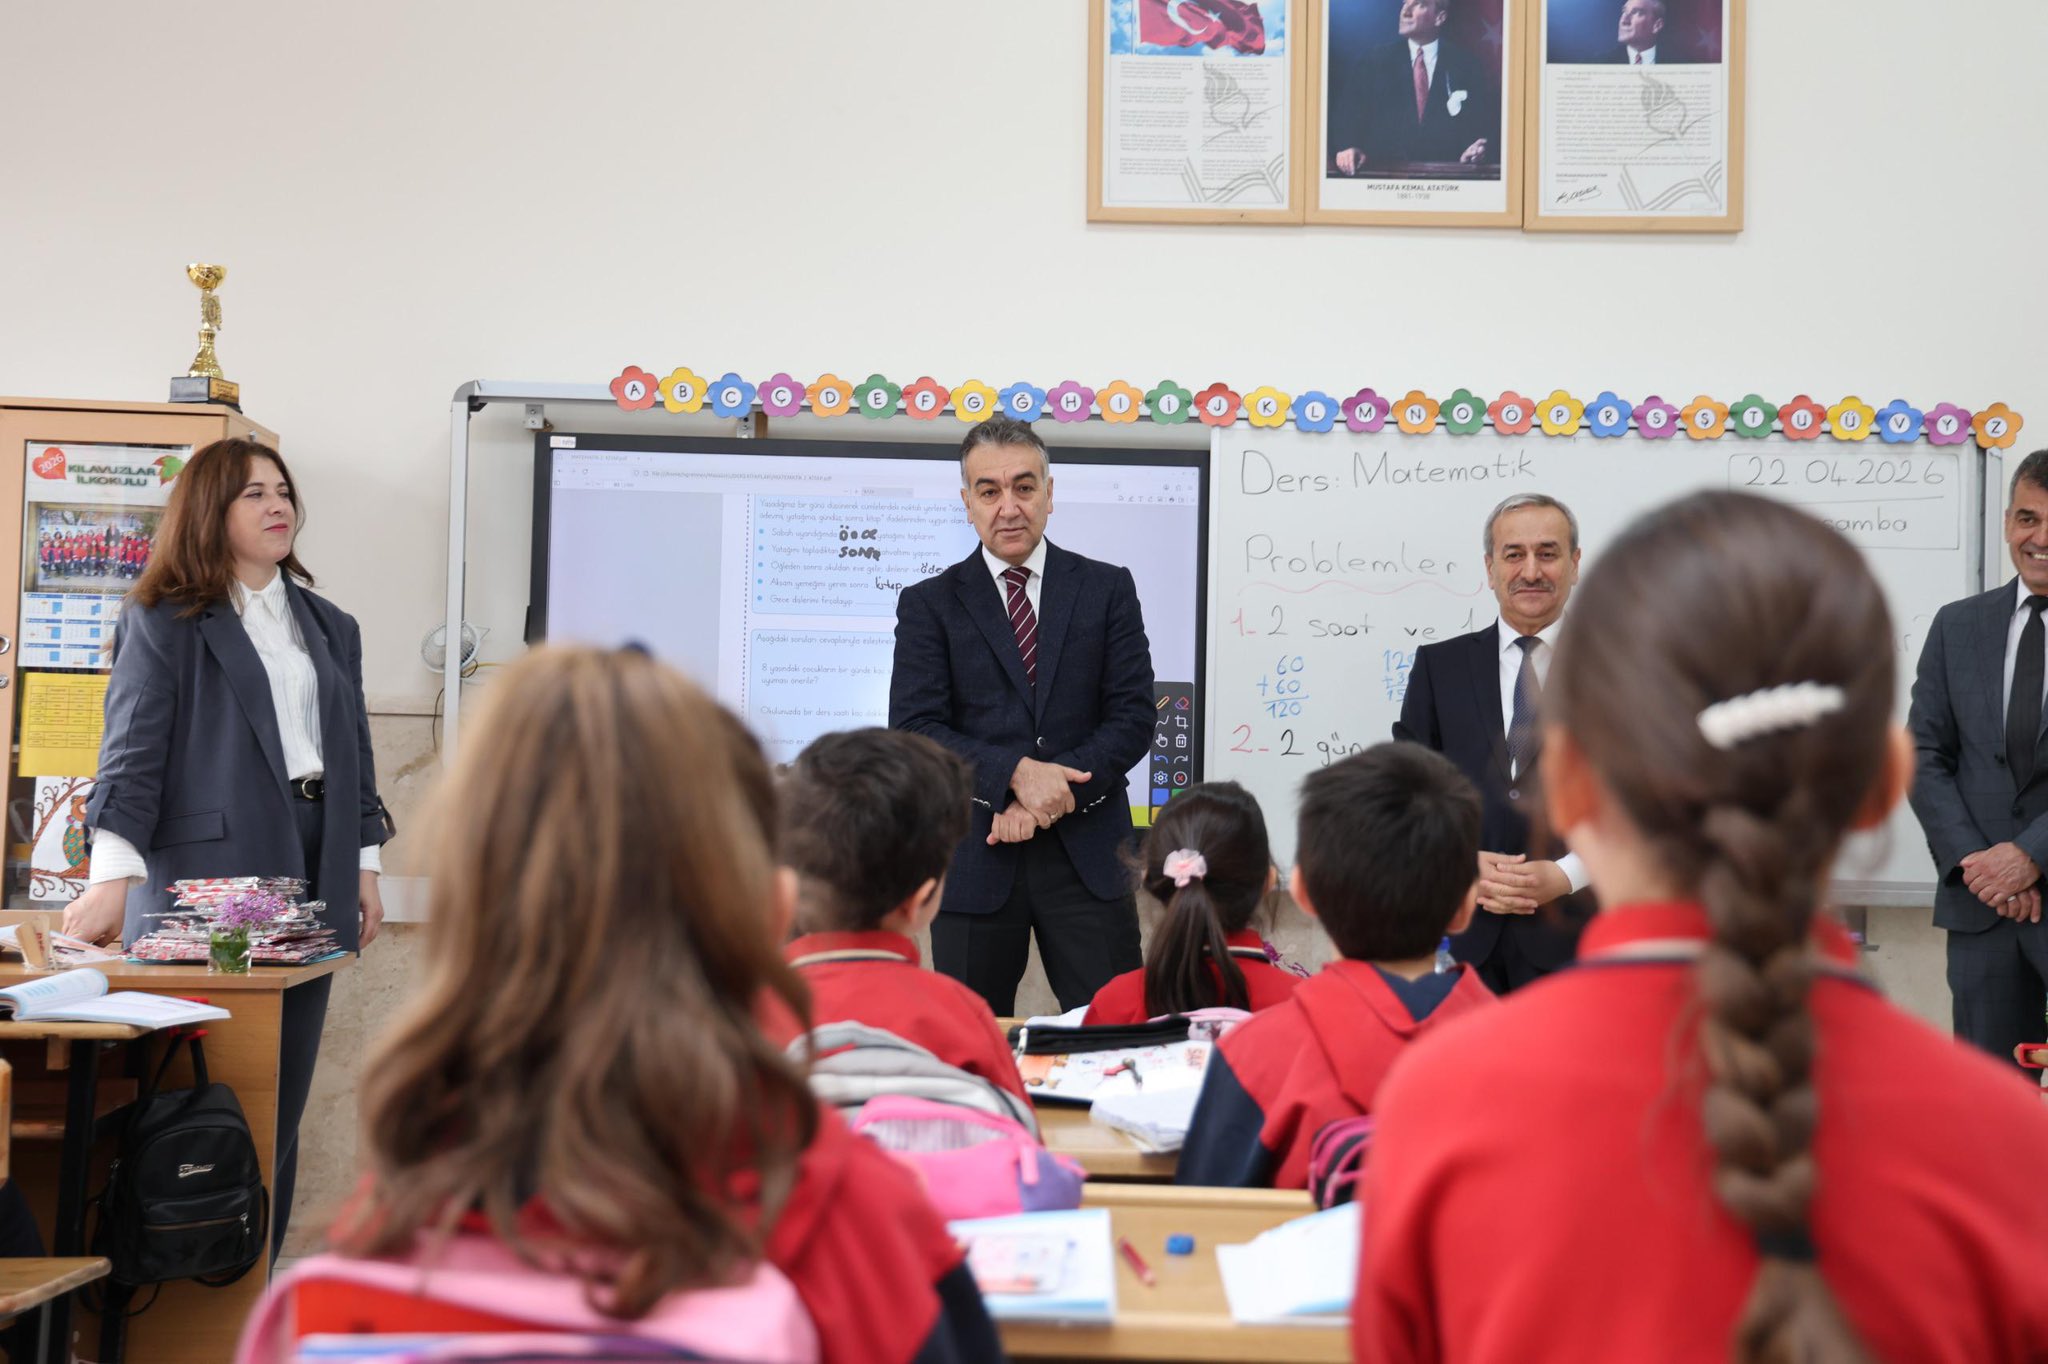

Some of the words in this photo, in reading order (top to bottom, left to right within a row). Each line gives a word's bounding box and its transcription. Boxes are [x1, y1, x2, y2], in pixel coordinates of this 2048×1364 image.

[1401, 184, 1425, 192] KEMAL
[1427, 184, 1460, 192] ATATÜRK
[631, 384, 640, 395] A
[680, 386, 687, 397] B
[726, 391, 735, 403] C
[776, 390, 785, 403] Ç
[826, 392, 835, 403] D
[874, 393, 881, 404] E
[922, 395, 929, 406] F
[968, 397, 980, 408] G
[1017, 394, 1028, 408] Ğ
[1066, 397, 1076, 407] H
[1214, 400, 1221, 411] J
[1264, 402, 1271, 413] K
[1312, 407, 1319, 417] L
[1360, 407, 1371, 417] M
[1411, 409, 1420, 419] N
[1457, 408, 1468, 419] O
[1506, 406, 1518, 421] Ö
[1557, 410, 1563, 421] P
[1605, 411, 1613, 421] R
[1654, 413, 1660, 424] S
[1702, 413, 1708, 427] Ş
[1749, 411, 1757, 422] T
[1798, 416, 1806, 426] U
[1846, 413, 1855, 427] Ü
[1895, 418, 1905, 428] V
[1943, 419, 1952, 430] Y
[1992, 421, 2000, 433] Z
[39, 454, 64, 473] 2026
[68, 464, 156, 476] KILAVUZLAR
[1241, 450, 1339, 494] Ders:
[1353, 449, 1536, 487] Matematik
[77, 475, 147, 487] İLKOKULU
[771, 527, 794, 537] Sabah
[1246, 533, 1457, 574] Problemler
[824, 563, 850, 572] okuldan
[769, 594, 790, 604] Gece
[1268, 605, 1288, 636] 2
[1404, 626, 1439, 639] ve
[761, 663, 768, 671] 8
[838, 665, 848, 674] bir
[850, 668, 871, 677] günde
[1276, 655, 1304, 675] 60
[803, 708, 812, 716] bir
[815, 708, 831, 717] ders
[1265, 701, 1302, 718] 120
[1281, 729, 1305, 756] 2
